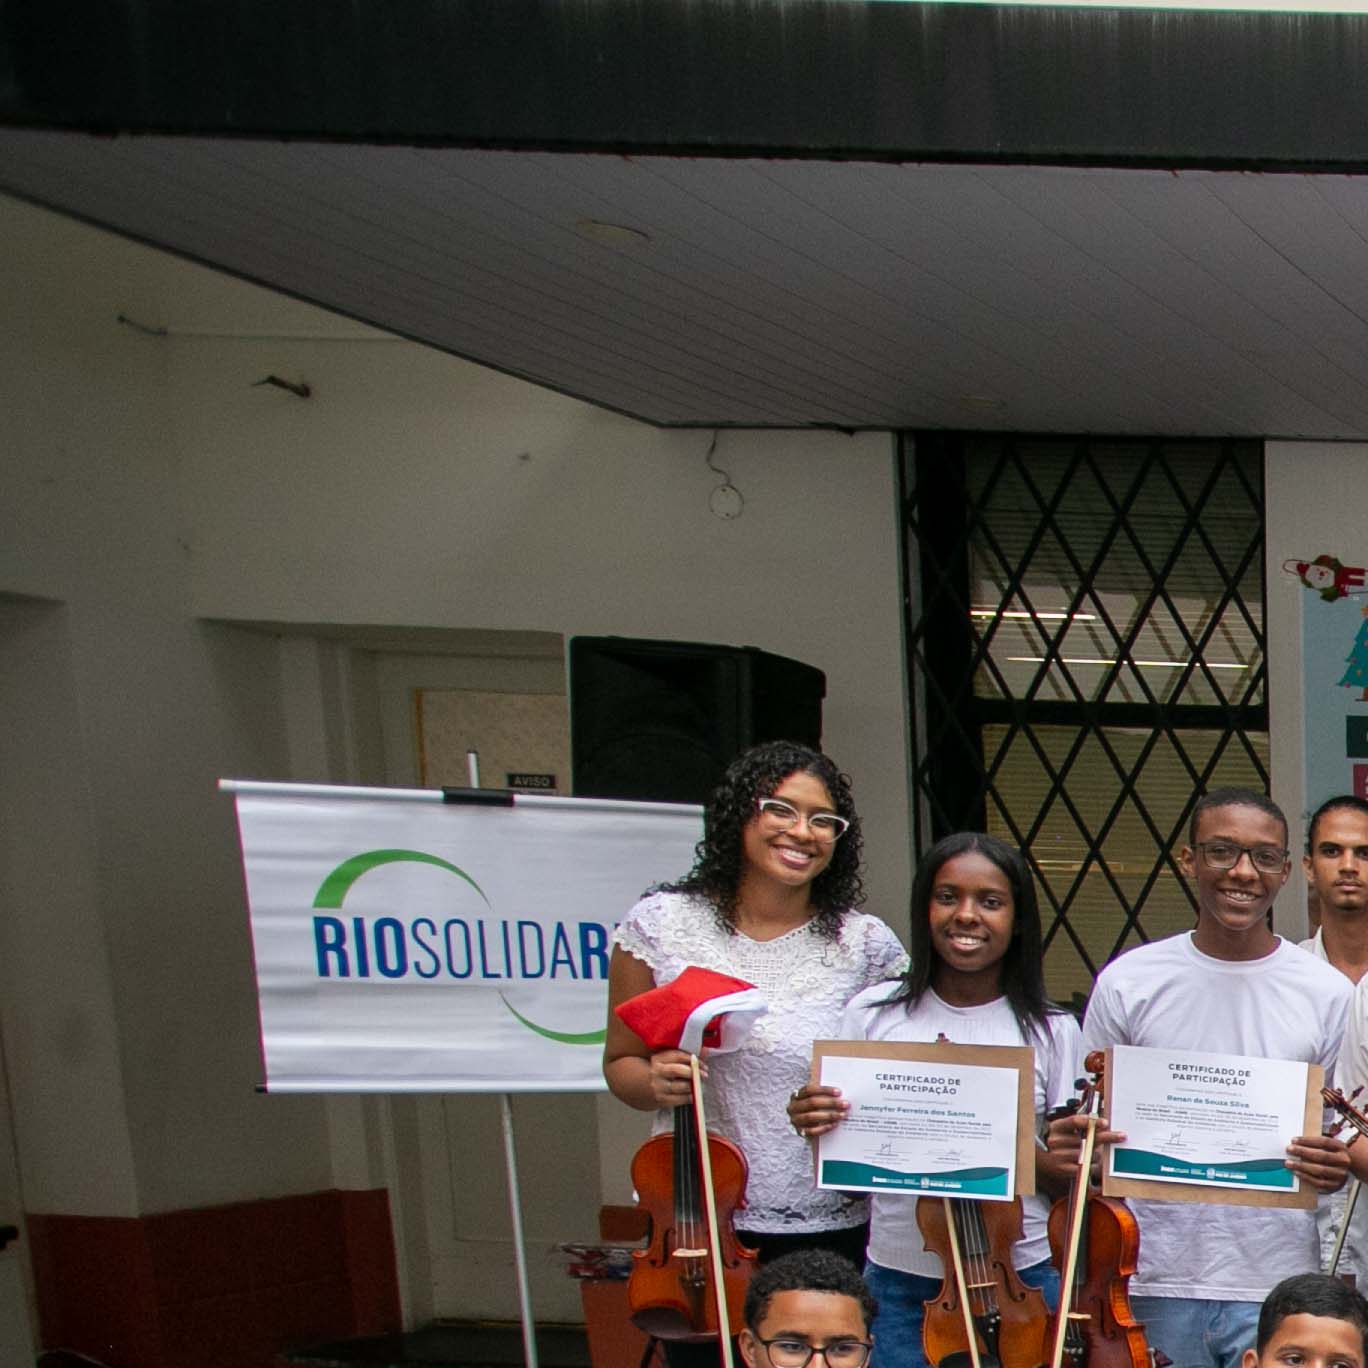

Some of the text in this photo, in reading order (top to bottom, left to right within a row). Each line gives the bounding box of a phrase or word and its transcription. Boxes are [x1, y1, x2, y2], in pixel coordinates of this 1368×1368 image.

[513, 776, 550, 786] AVISO
[312, 916, 620, 980] RIOSOLIDAR
[1168, 1063, 1236, 1076] CERTIFICADO
[875, 1073, 961, 1086] CERTIFICADO DE
[1172, 1073, 1246, 1086] PARTICIPAÇÃO
[880, 1083, 957, 1095] PARTICIPAÇÃO
[931, 1108, 946, 1116] dos
[947, 1110, 976, 1118] Santos
